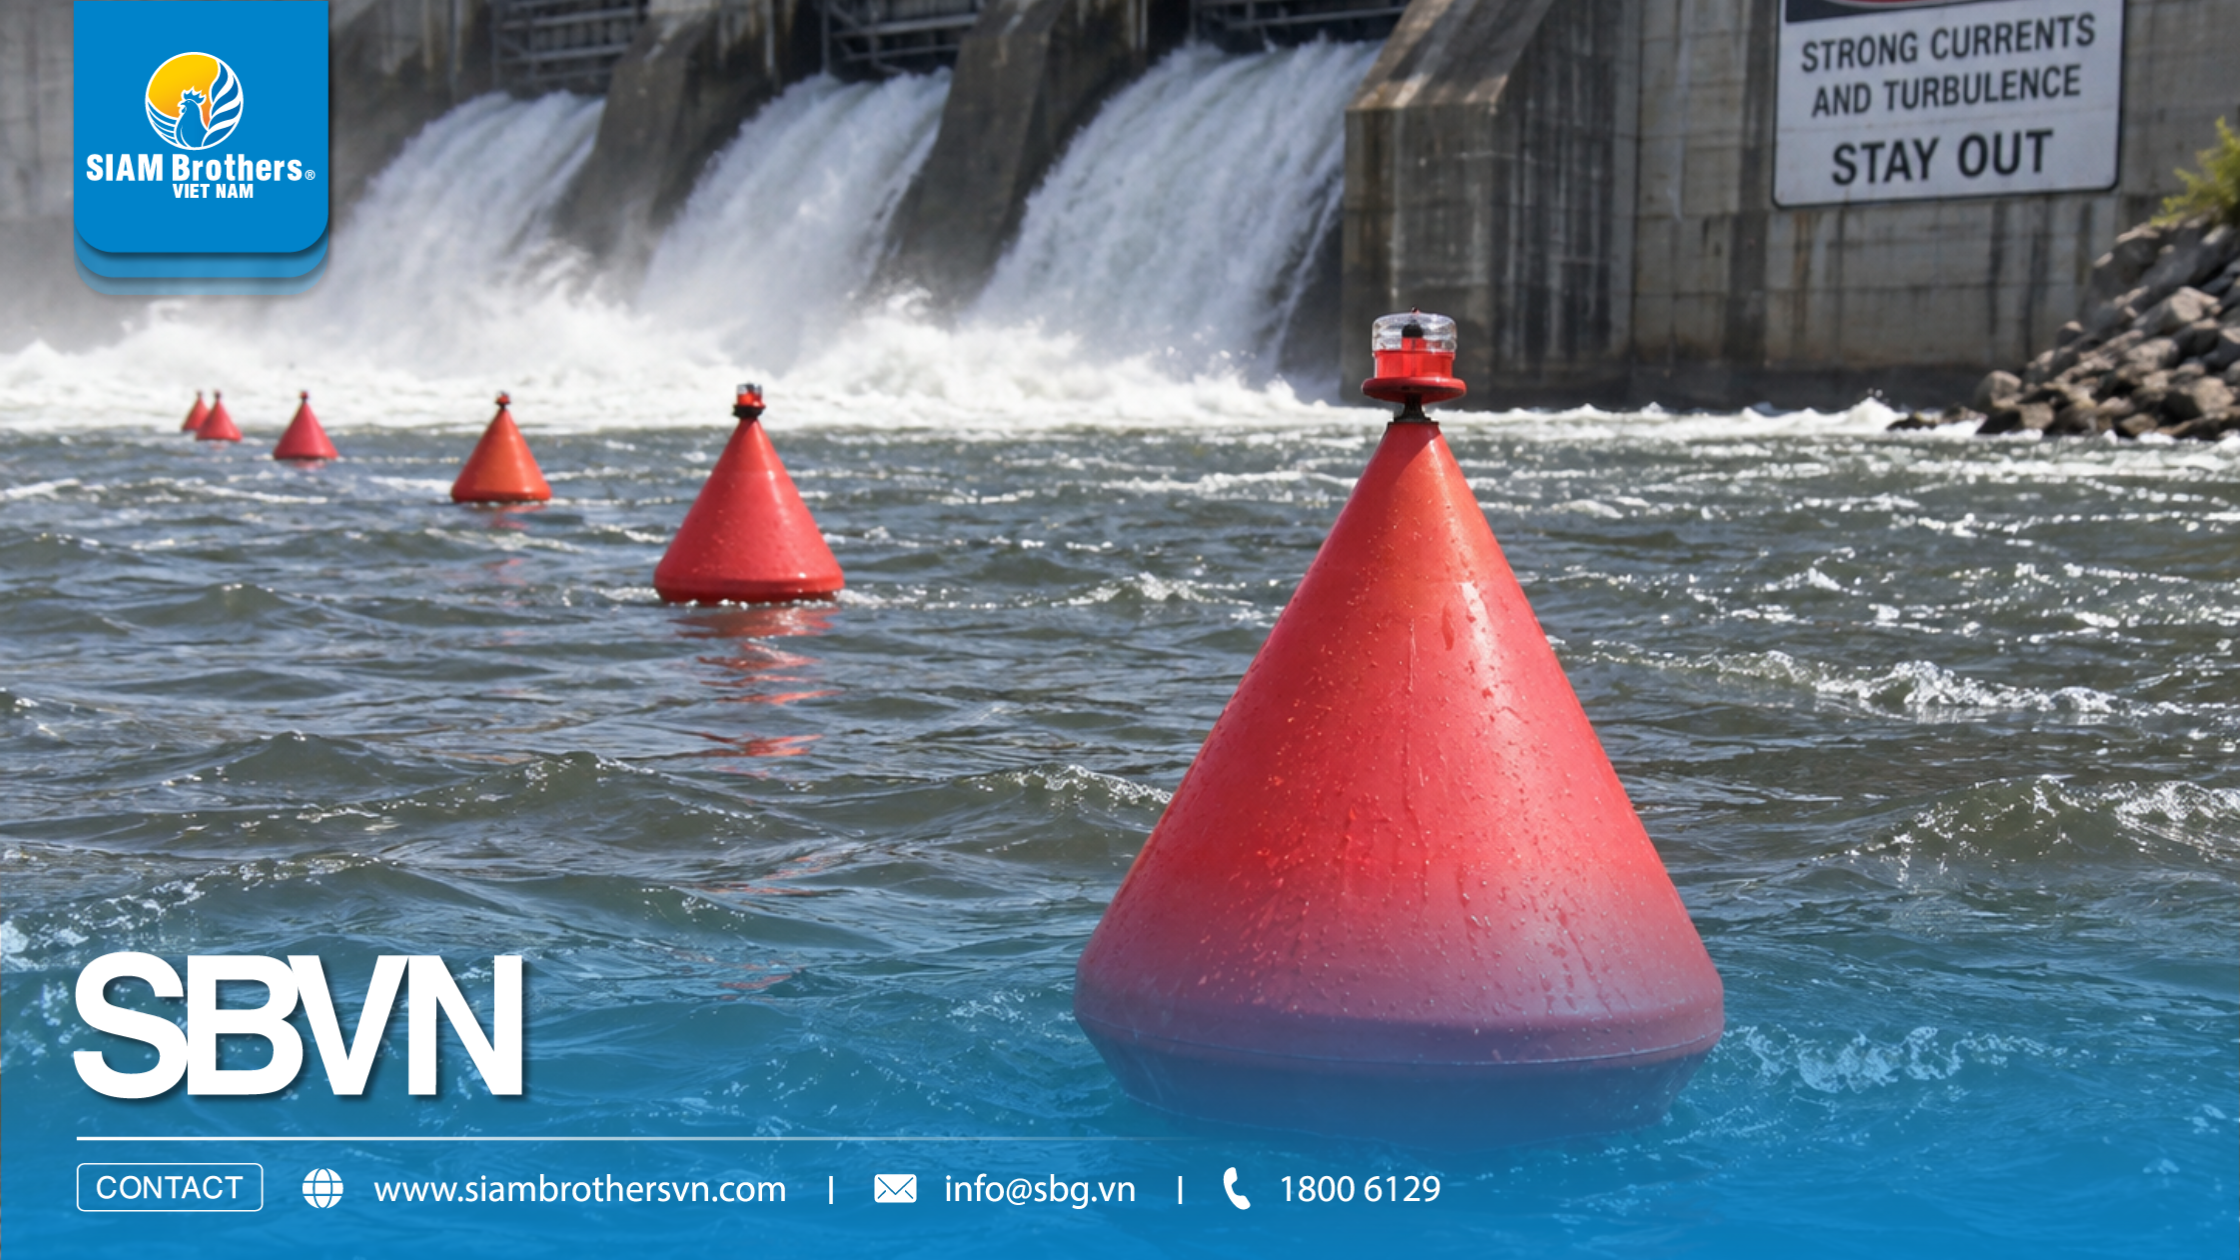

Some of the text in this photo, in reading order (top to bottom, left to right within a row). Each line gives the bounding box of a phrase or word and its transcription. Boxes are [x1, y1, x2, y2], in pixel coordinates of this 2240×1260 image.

[1802, 13, 2096, 72] STRONG CURRENTS
[1811, 64, 2081, 118] AND TURBULENCE
[1831, 129, 2053, 185] STAY OUT
